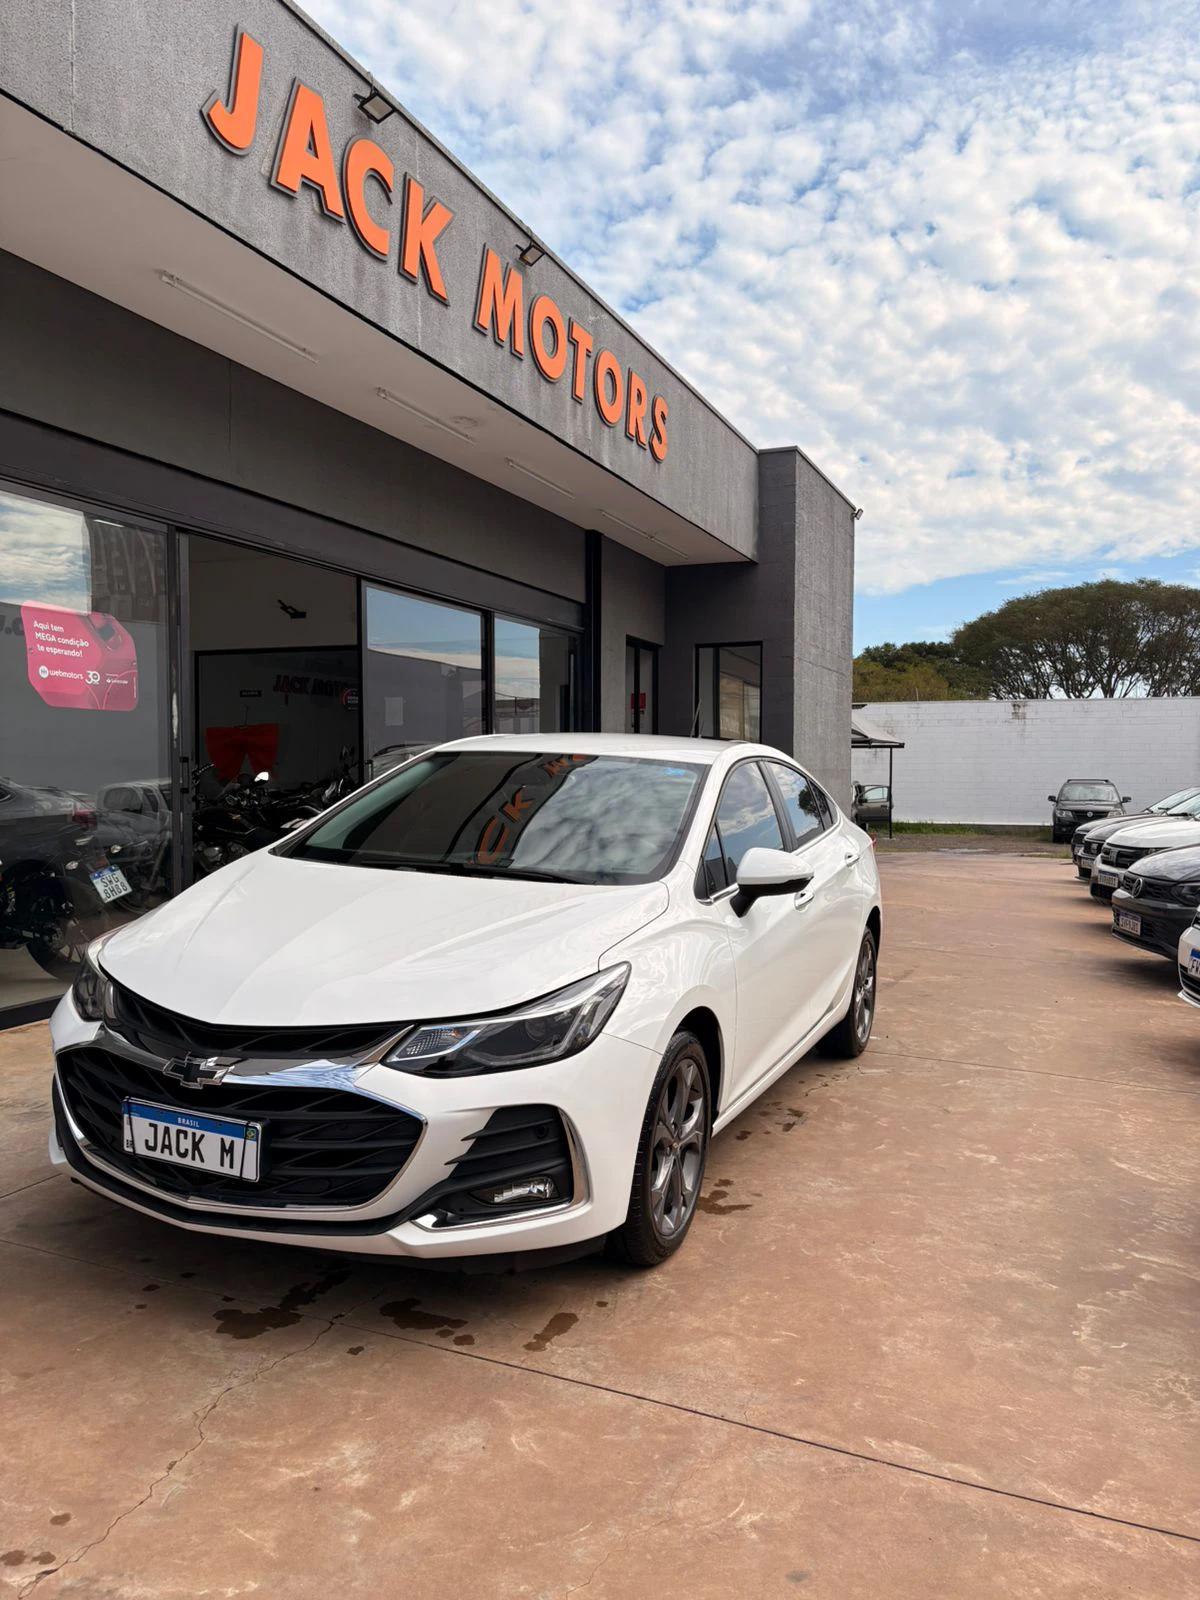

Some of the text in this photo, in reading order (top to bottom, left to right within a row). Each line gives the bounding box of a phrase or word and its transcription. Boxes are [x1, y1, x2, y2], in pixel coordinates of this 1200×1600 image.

[202, 28, 669, 462] JACK MOTORS
[33, 620, 50, 631] Aqui
[50, 623, 65, 632] tem
[34, 632, 90, 648] MEGA condição
[37, 644, 83, 657] te esperando!
[49, 669, 84, 680] webmotors
[177, 1116, 200, 1128] BRASIL
[144, 1123, 235, 1170] JACK M
